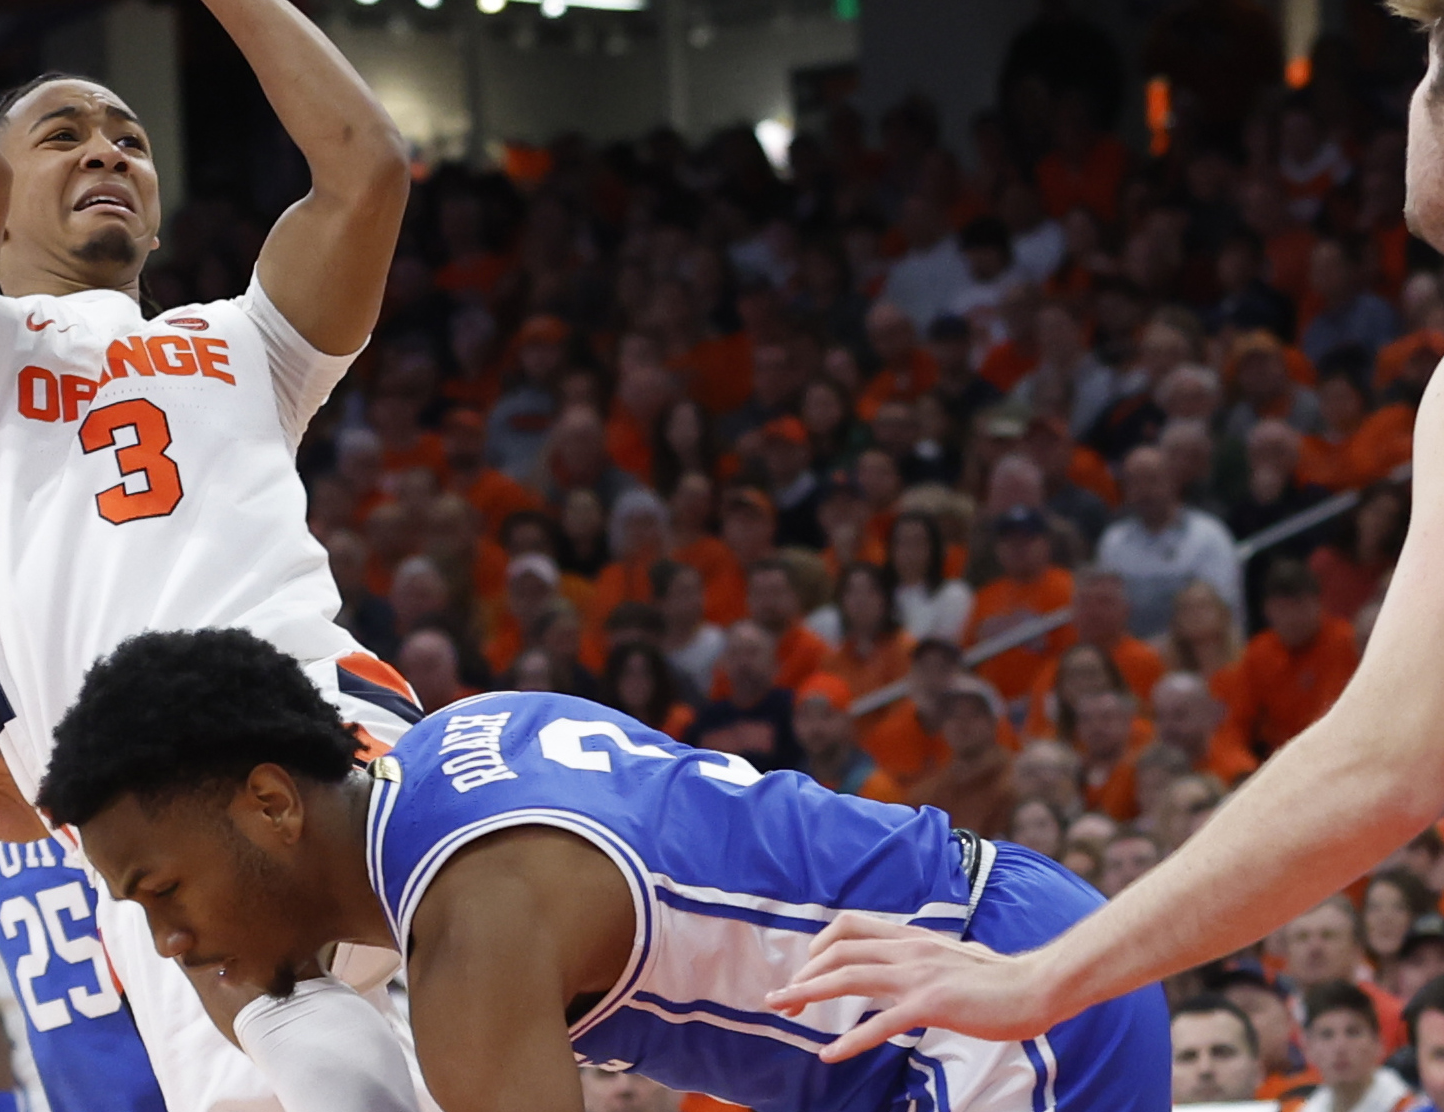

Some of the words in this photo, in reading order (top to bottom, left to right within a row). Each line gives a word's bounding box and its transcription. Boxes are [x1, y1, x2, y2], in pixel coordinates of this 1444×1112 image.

[78, 398, 184, 526] 3
[438, 711, 519, 794] ROACH
[0, 881, 122, 1032] 25
